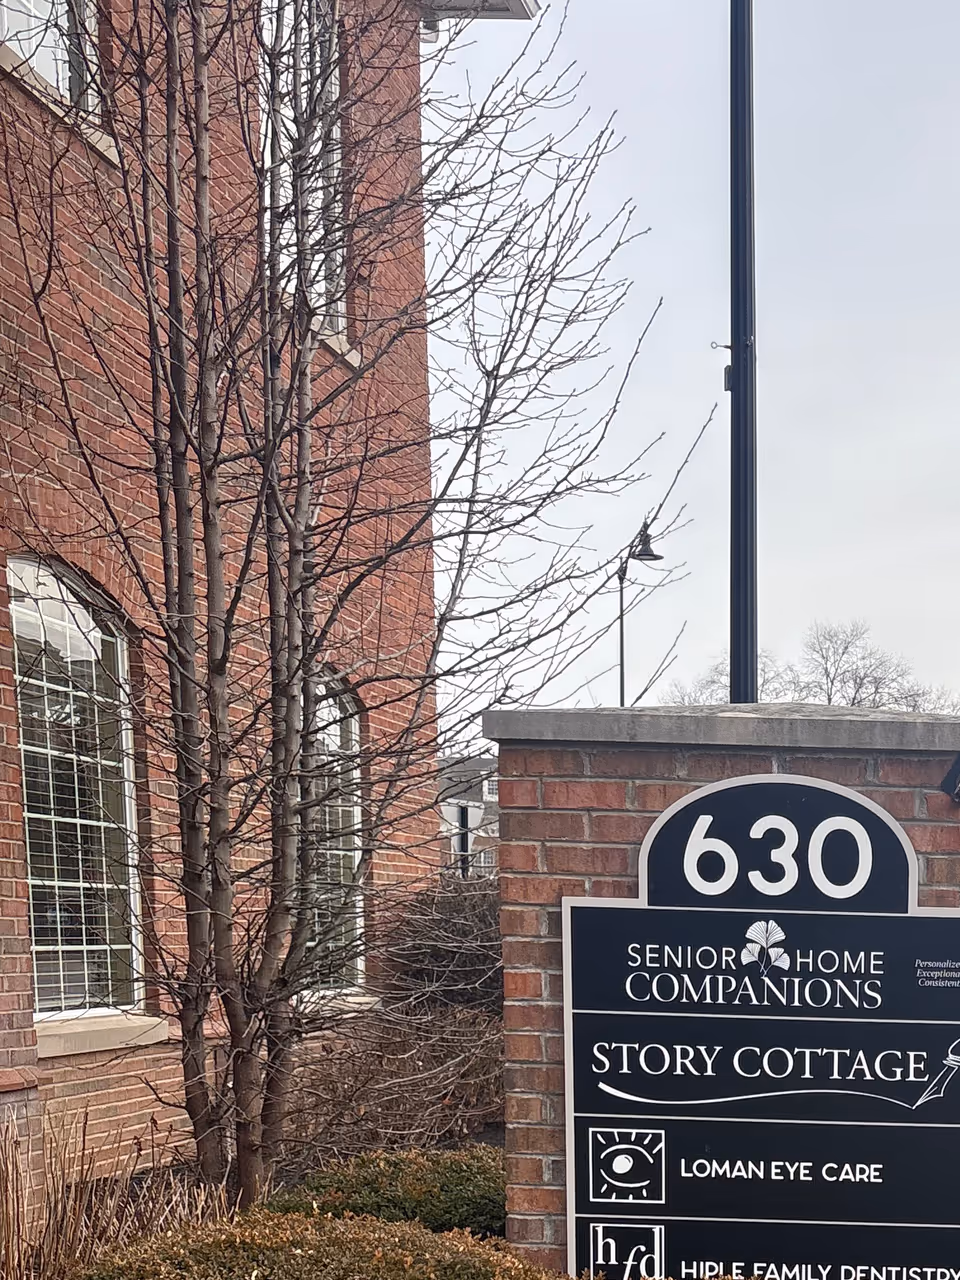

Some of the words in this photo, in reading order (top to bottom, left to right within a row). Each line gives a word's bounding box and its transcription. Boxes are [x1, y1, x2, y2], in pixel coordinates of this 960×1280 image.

[683, 814, 873, 899] 630
[627, 943, 737, 970] SENIOR
[796, 949, 885, 975] HOME
[625, 971, 883, 1009] COMPANIONS
[591, 1041, 723, 1076] STORY
[732, 1046, 930, 1082] COTTAGE
[680, 1158, 765, 1180] LOMAN
[770, 1161, 813, 1181] EYE
[821, 1162, 884, 1183] CARE
